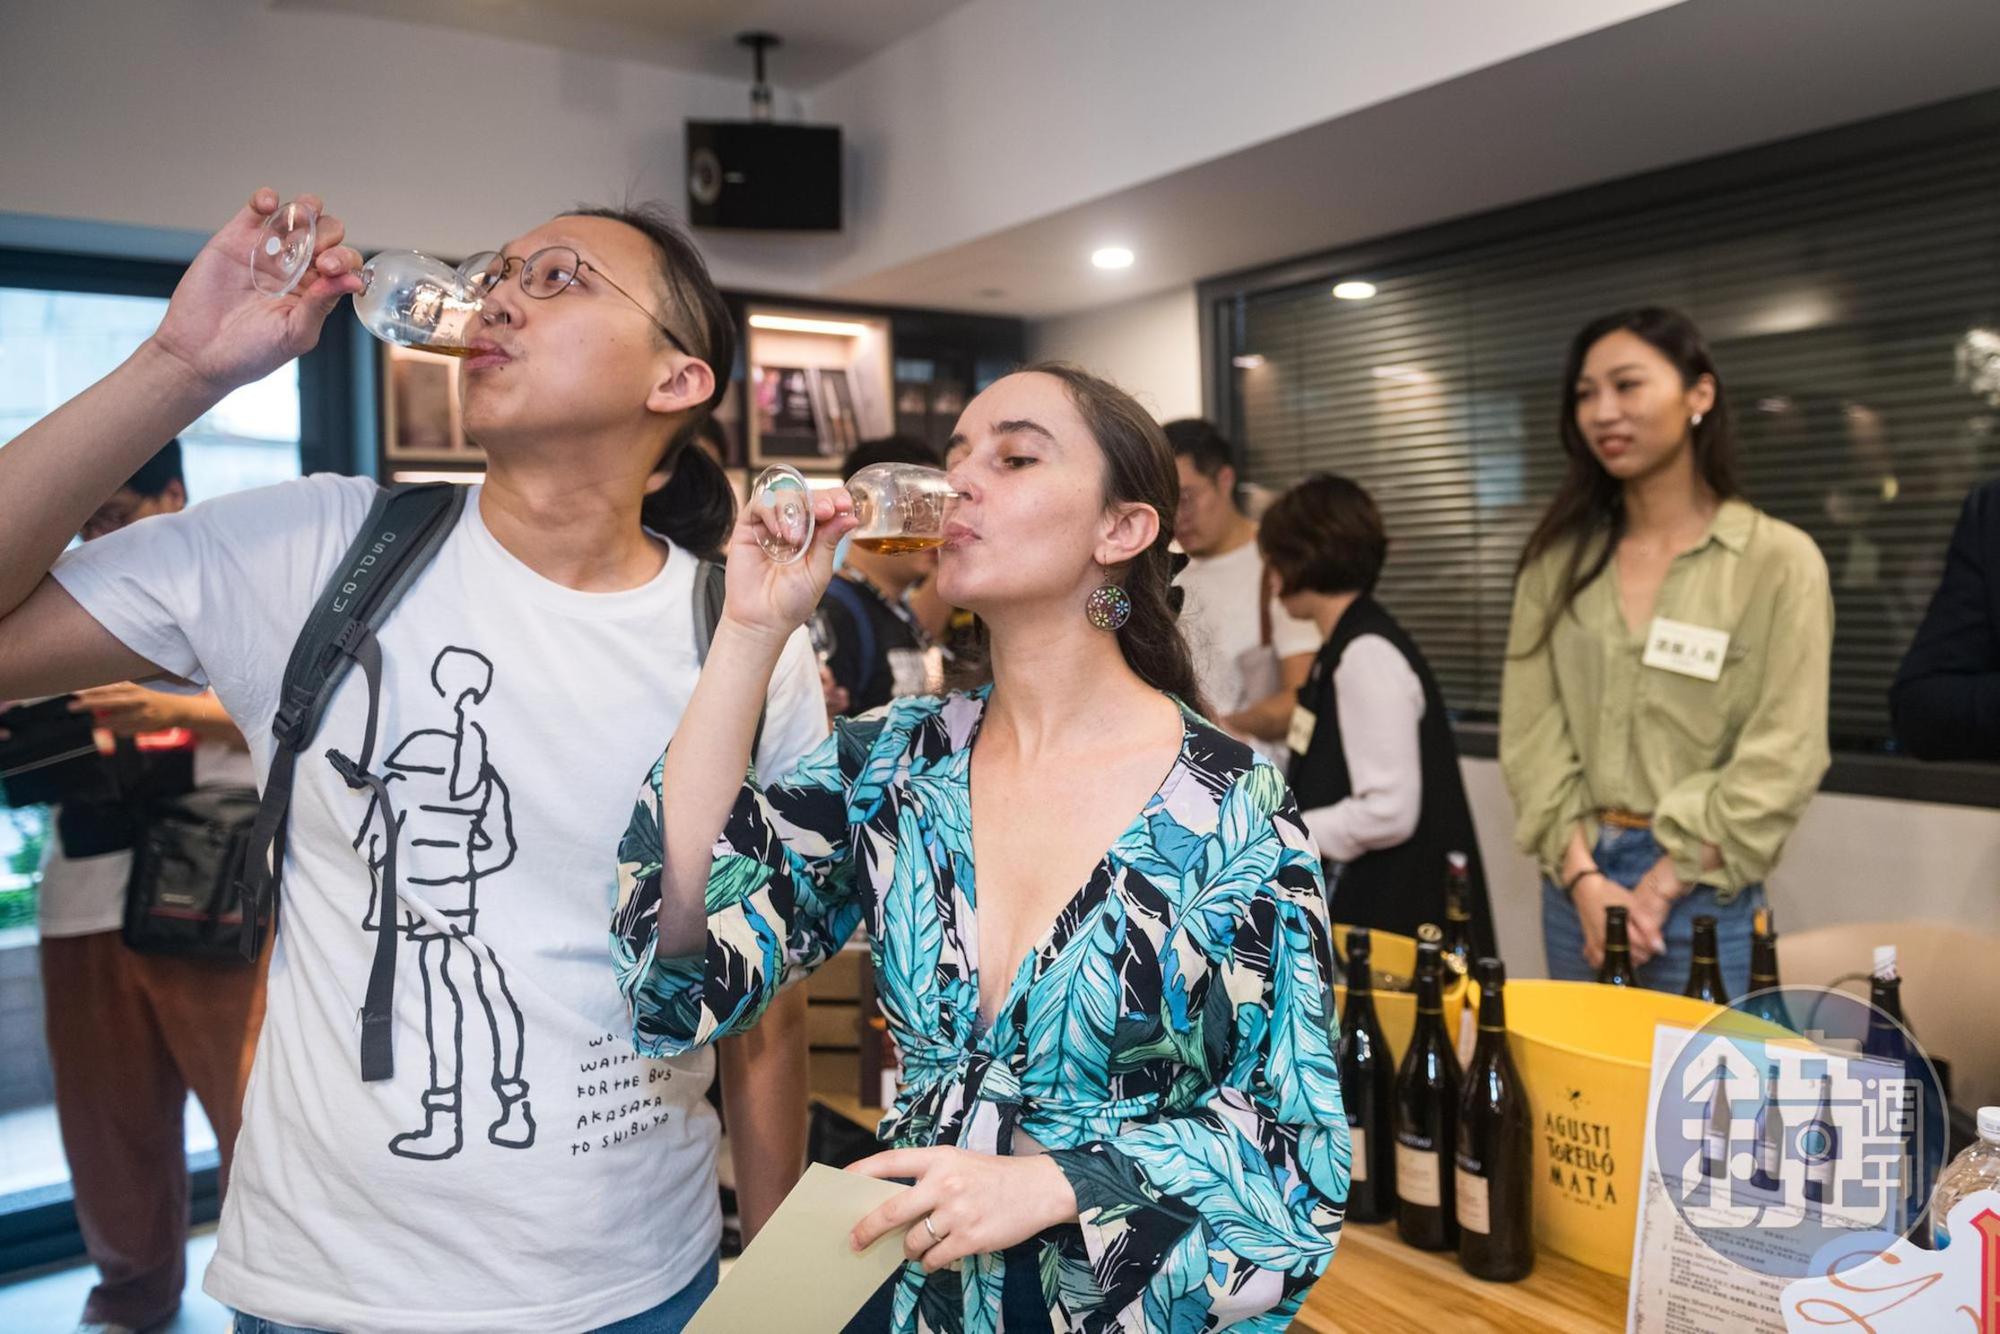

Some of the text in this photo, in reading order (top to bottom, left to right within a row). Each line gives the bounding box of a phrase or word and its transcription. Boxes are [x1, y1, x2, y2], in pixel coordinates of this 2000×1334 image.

[333, 532, 396, 612] osprey
[577, 1068, 672, 1098] FOR THE BUS
[577, 1096, 662, 1130] AKASAKA
[571, 1112, 669, 1156] TO SHIBUYA
[1550, 1166, 1617, 1204] MATA
